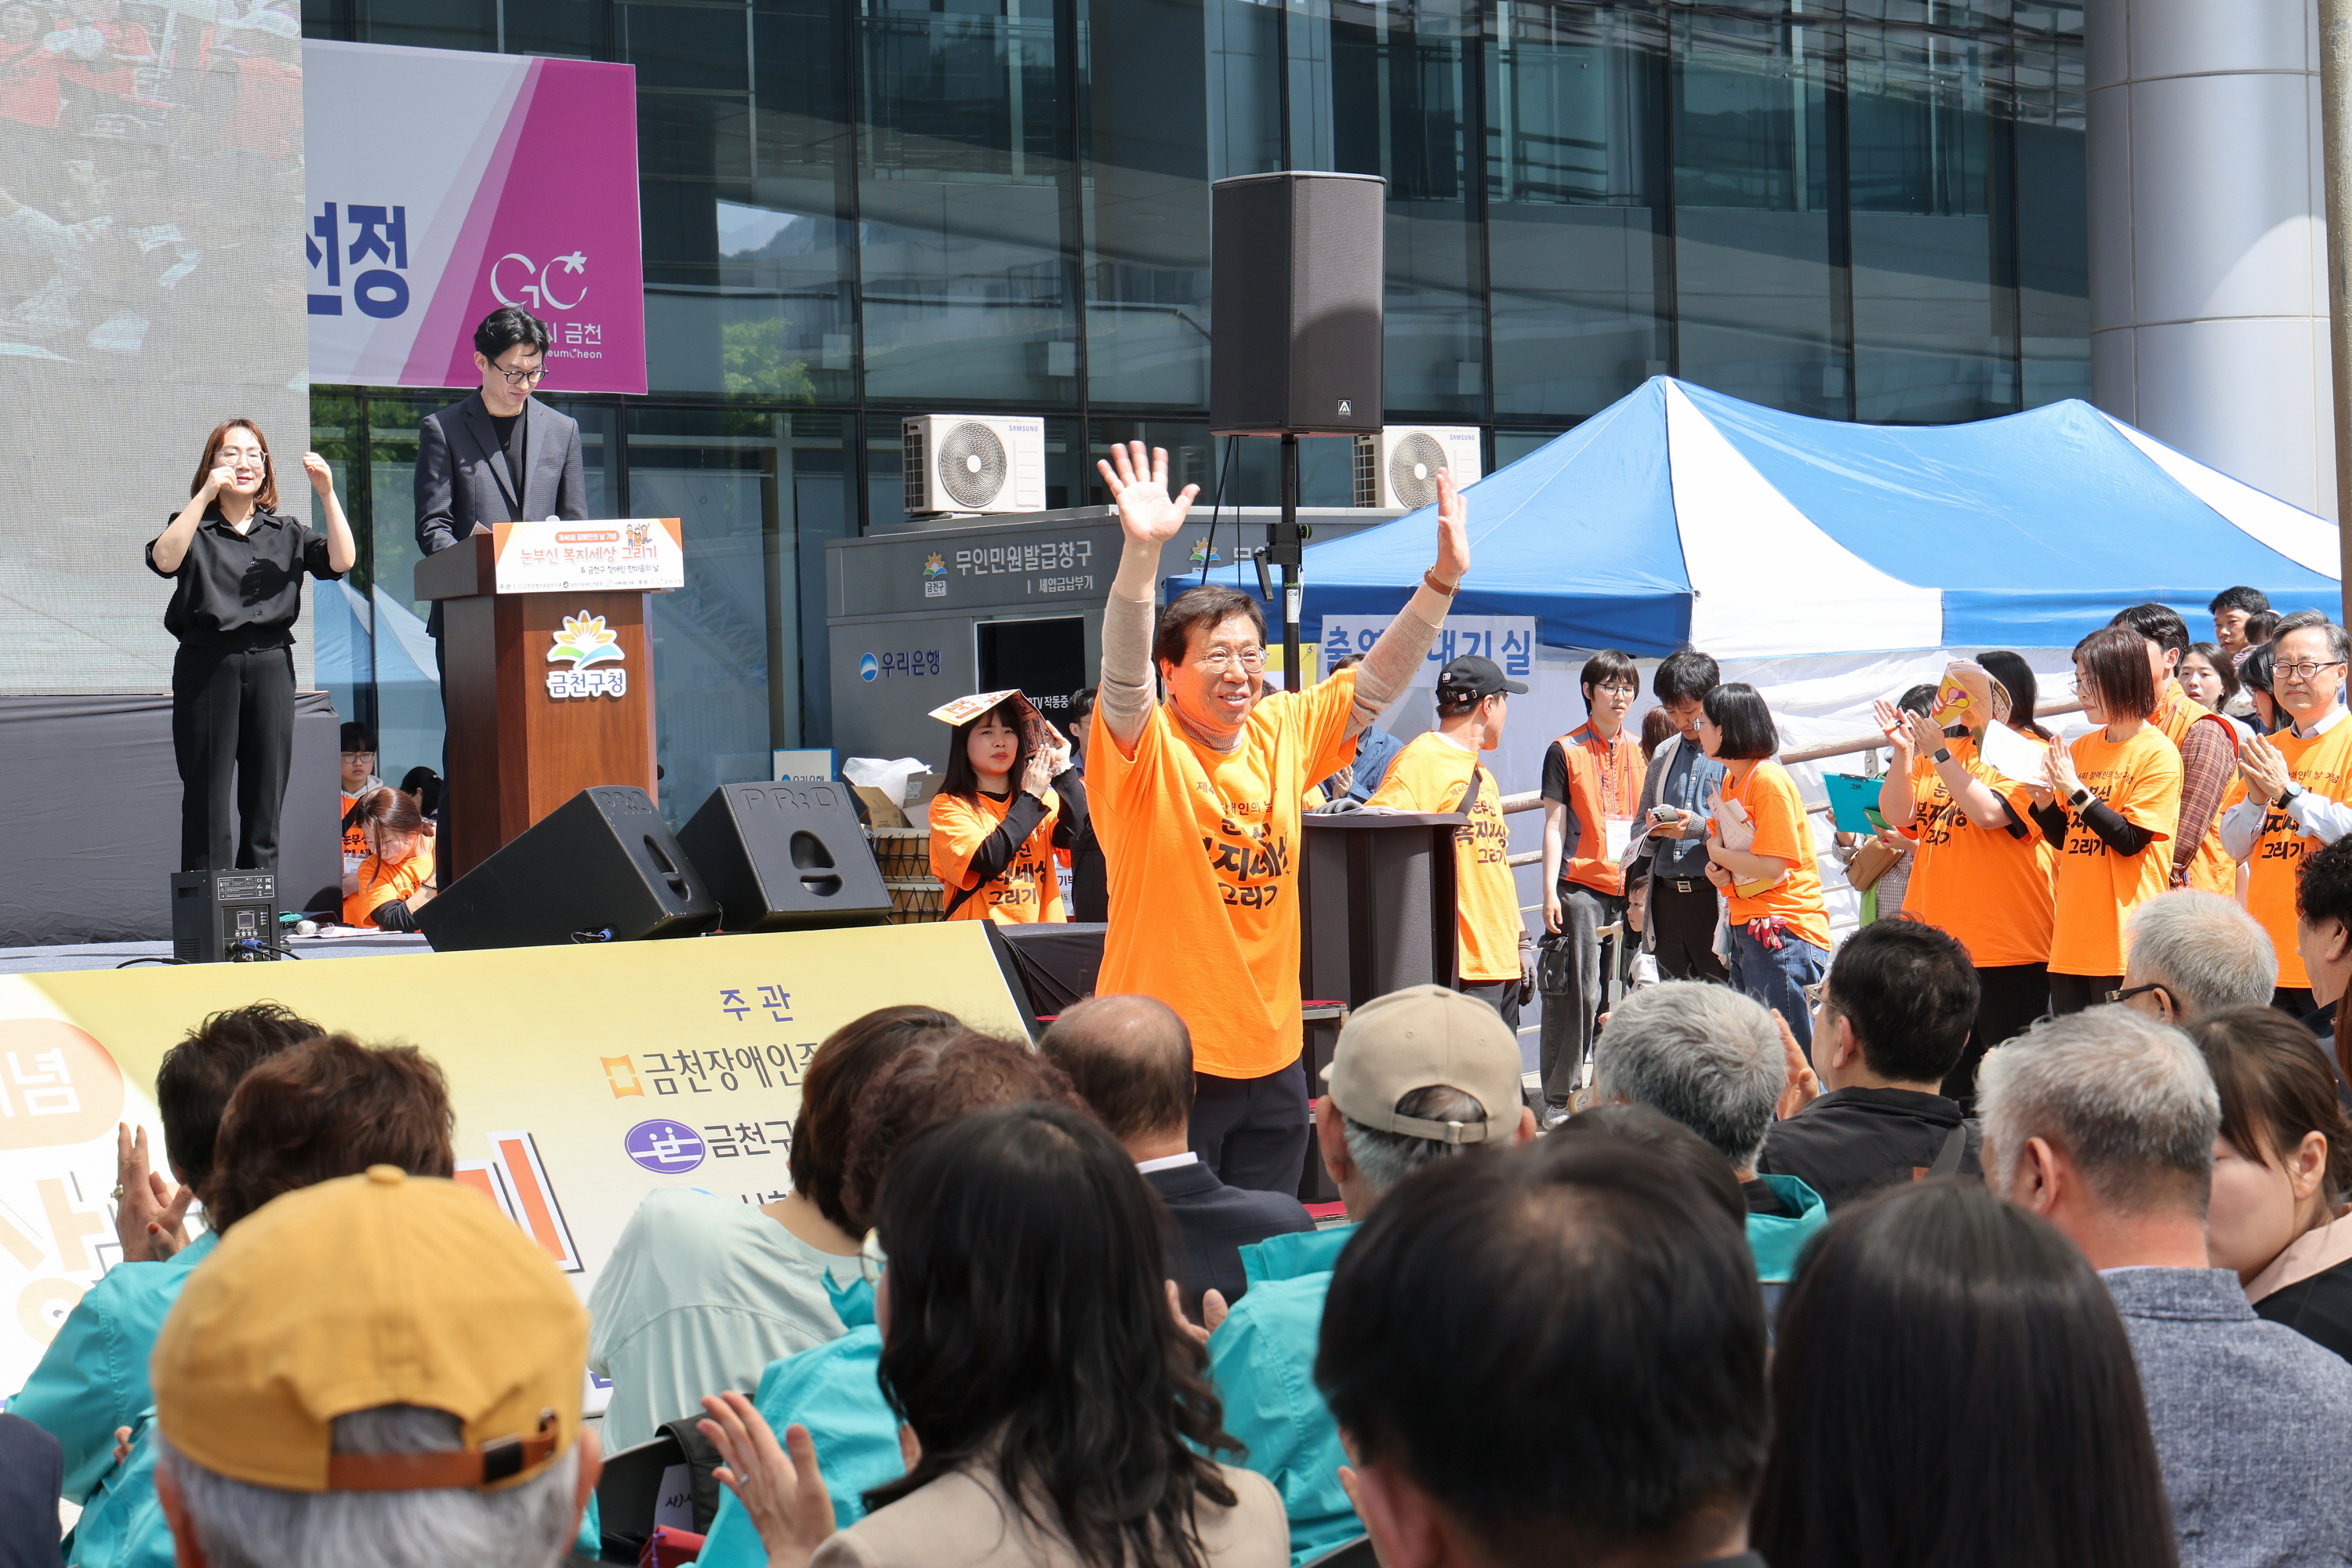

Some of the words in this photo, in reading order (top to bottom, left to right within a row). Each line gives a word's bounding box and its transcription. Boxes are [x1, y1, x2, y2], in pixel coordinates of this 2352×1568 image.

[564, 322, 601, 345] 금천
[546, 348, 602, 359] eumCheon
[521, 548, 558, 565] 눈부신
[564, 546, 617, 564] 복지세상
[621, 545, 658, 560] 그리기
[956, 540, 1093, 575] 무인민원발급창구
[588, 566, 605, 575] 금천구
[627, 564, 652, 573] 한마음의
[927, 582, 945, 593] 금천구
[1038, 575, 1094, 593] 세입금납부기
[881, 650, 941, 677] 우리은행
[550, 672, 623, 695] 금천구청
[1044, 695, 1069, 710] 작동중
[2314, 771, 2323, 780] 날
[2068, 838, 2106, 856] 그리기
[2261, 841, 2305, 860] 그리기
[989, 887, 1036, 906] 그리기
